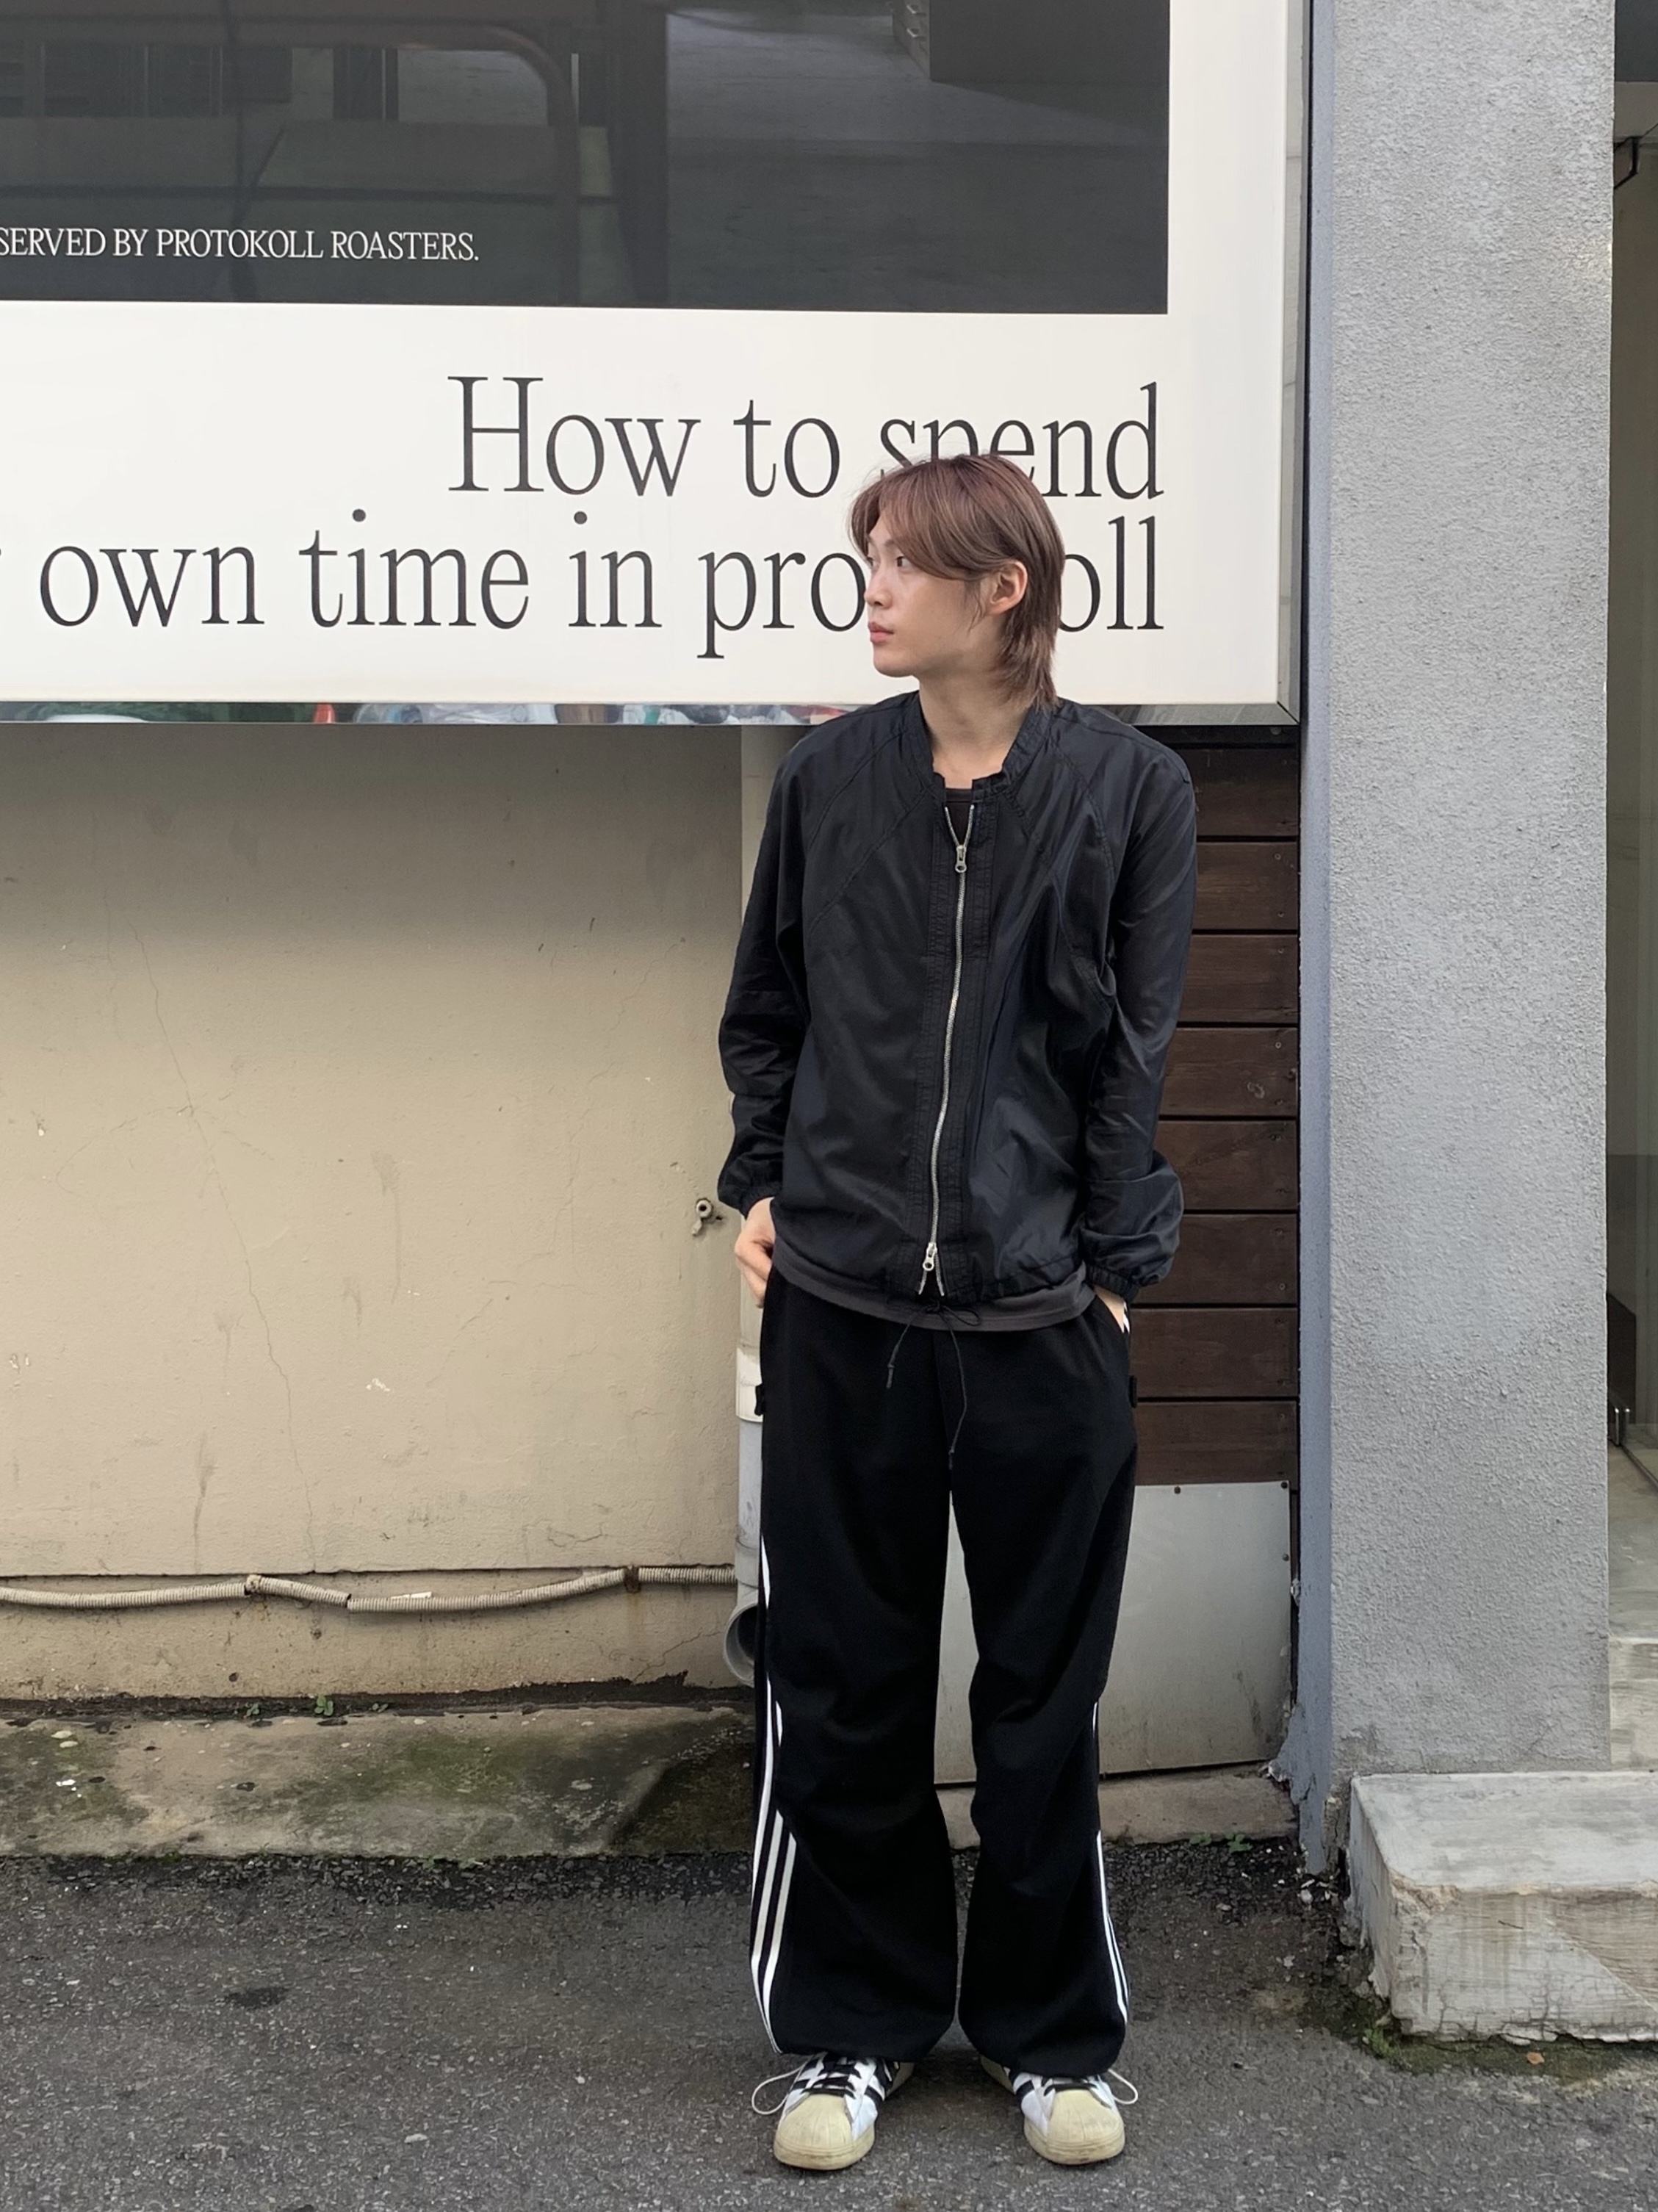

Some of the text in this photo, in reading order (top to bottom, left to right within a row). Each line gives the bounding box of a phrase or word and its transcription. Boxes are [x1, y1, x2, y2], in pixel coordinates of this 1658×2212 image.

[112, 228, 149, 256] BY
[156, 228, 324, 259] PROTOKOLL
[330, 230, 480, 262] ROASTERS.
[447, 376, 702, 497] How
[733, 400, 840, 498] to
[40, 508, 1165, 659] own time in prooll
